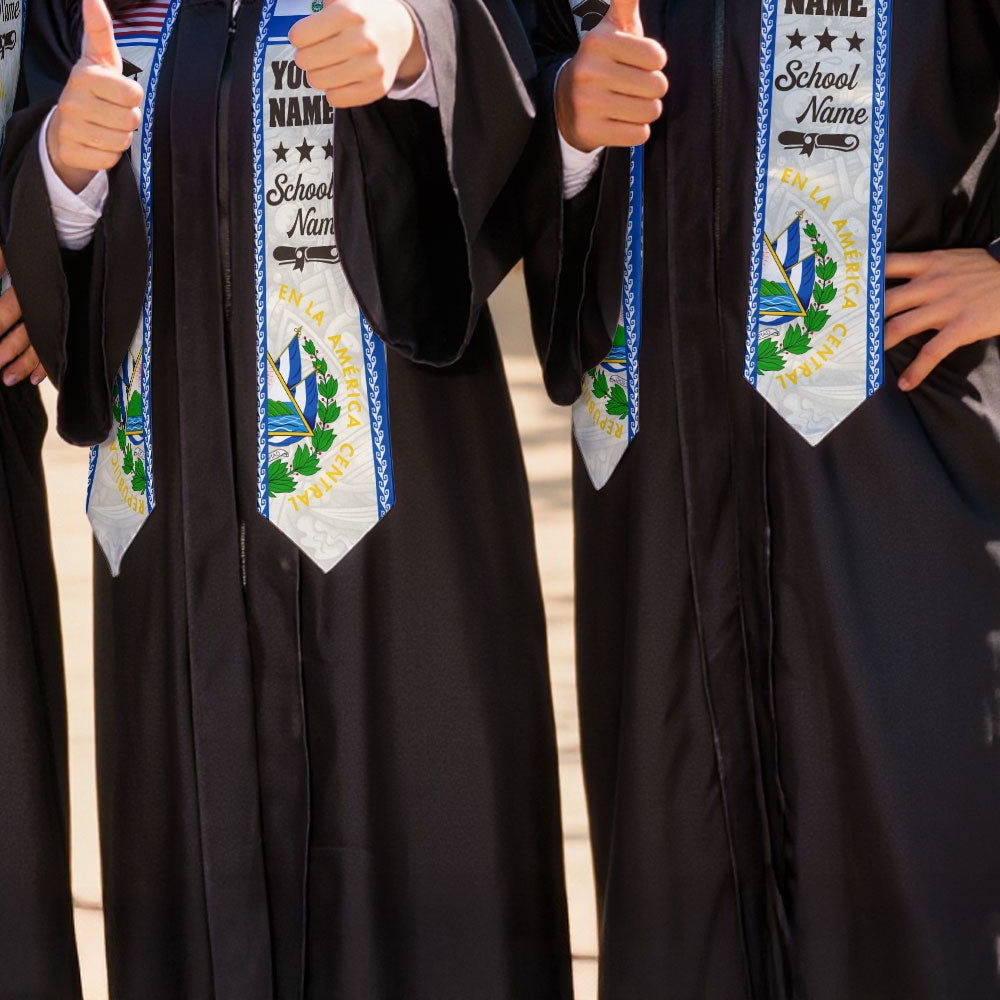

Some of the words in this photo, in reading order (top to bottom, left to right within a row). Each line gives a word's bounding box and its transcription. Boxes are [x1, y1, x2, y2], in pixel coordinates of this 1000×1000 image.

[774, 59, 861, 92] School
[795, 95, 869, 125] Name
[266, 171, 334, 206] School
[780, 167, 808, 192] EN
[809, 185, 832, 212] LA
[286, 206, 335, 238] Nam
[831, 218, 861, 310] AMÉRICA
[278, 284, 304, 308] EN
[304, 302, 325, 327] LA
[775, 323, 848, 390] CENTRAL
[327, 333, 362, 429] AMÉRICA
[287, 442, 355, 512] CENTRAL
